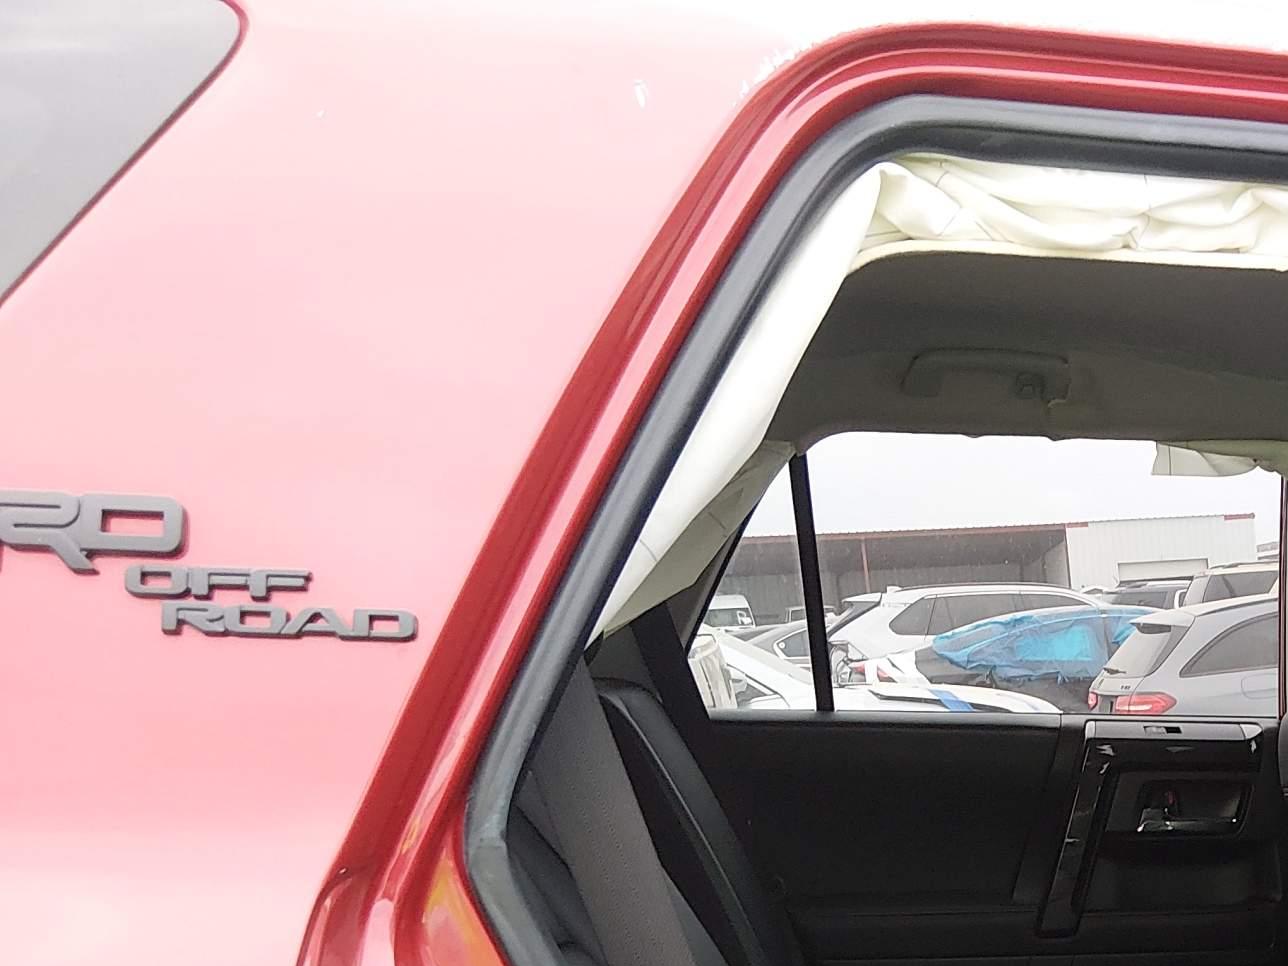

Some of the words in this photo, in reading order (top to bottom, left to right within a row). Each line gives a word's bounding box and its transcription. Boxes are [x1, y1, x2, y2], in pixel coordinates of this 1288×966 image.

[0, 488, 188, 575] RD
[125, 564, 312, 600] OFF
[161, 601, 418, 642] ROAD
